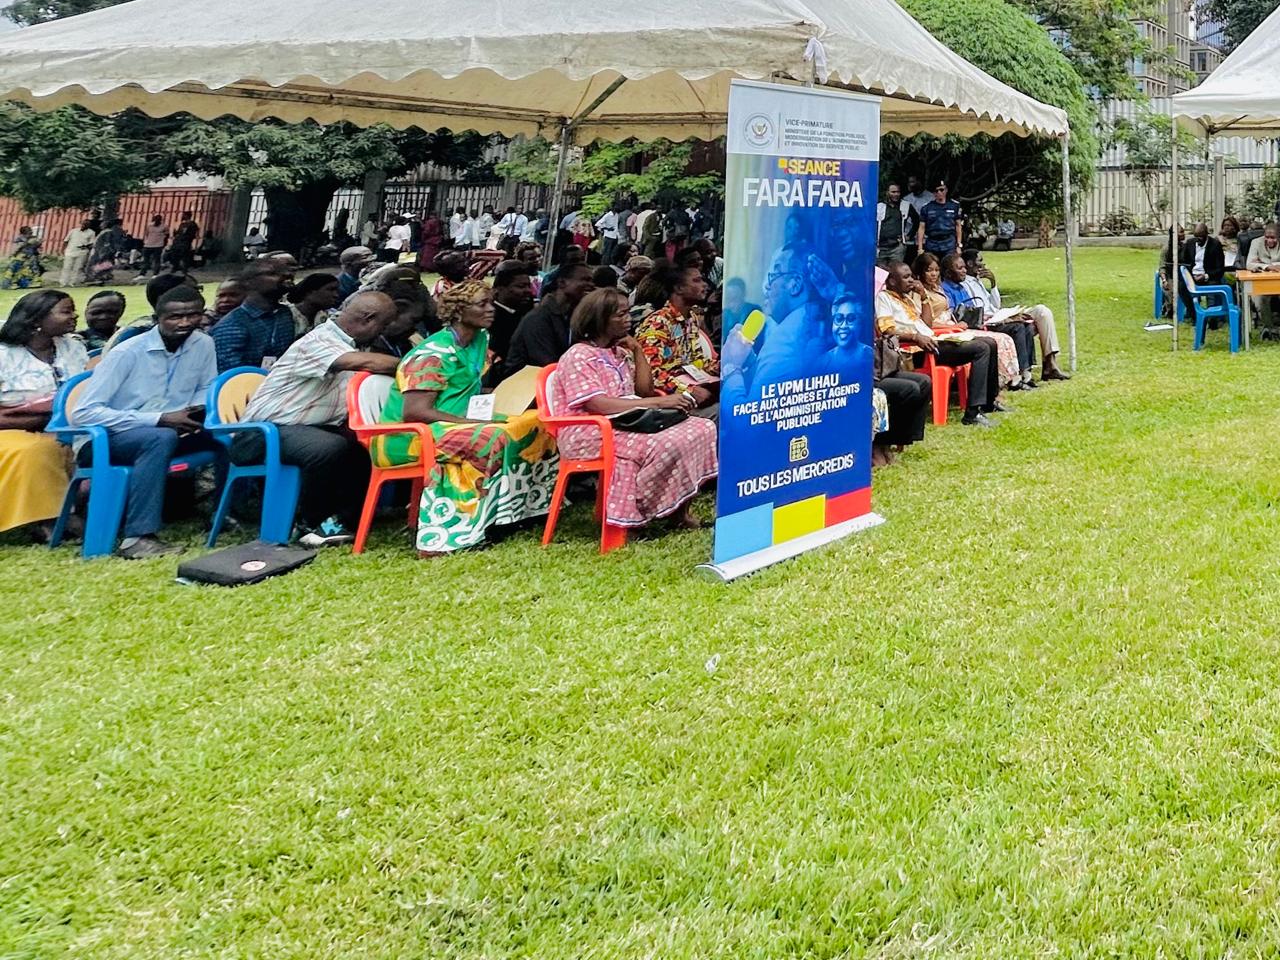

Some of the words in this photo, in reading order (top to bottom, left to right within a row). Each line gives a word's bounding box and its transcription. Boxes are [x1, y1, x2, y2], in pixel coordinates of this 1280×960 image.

[785, 118, 833, 129] VICE-PRIMATURE
[788, 158, 841, 177] SEANCE
[743, 177, 806, 208] FARA
[807, 179, 864, 208] FARA
[733, 401, 758, 416] FACE
[760, 398, 778, 412] AUX
[780, 391, 815, 407] CADRES
[816, 389, 828, 400] ET
[828, 383, 860, 398] AGENTS
[761, 383, 776, 399] LE
[777, 378, 803, 396] VPM
[805, 373, 839, 391] LIHAU
[750, 414, 765, 425] DE
[766, 397, 847, 423] L'ADMINISTRATION
[737, 475, 770, 497] TOUS
[771, 469, 792, 488] LES
[792, 453, 854, 483] MERCREDIS
